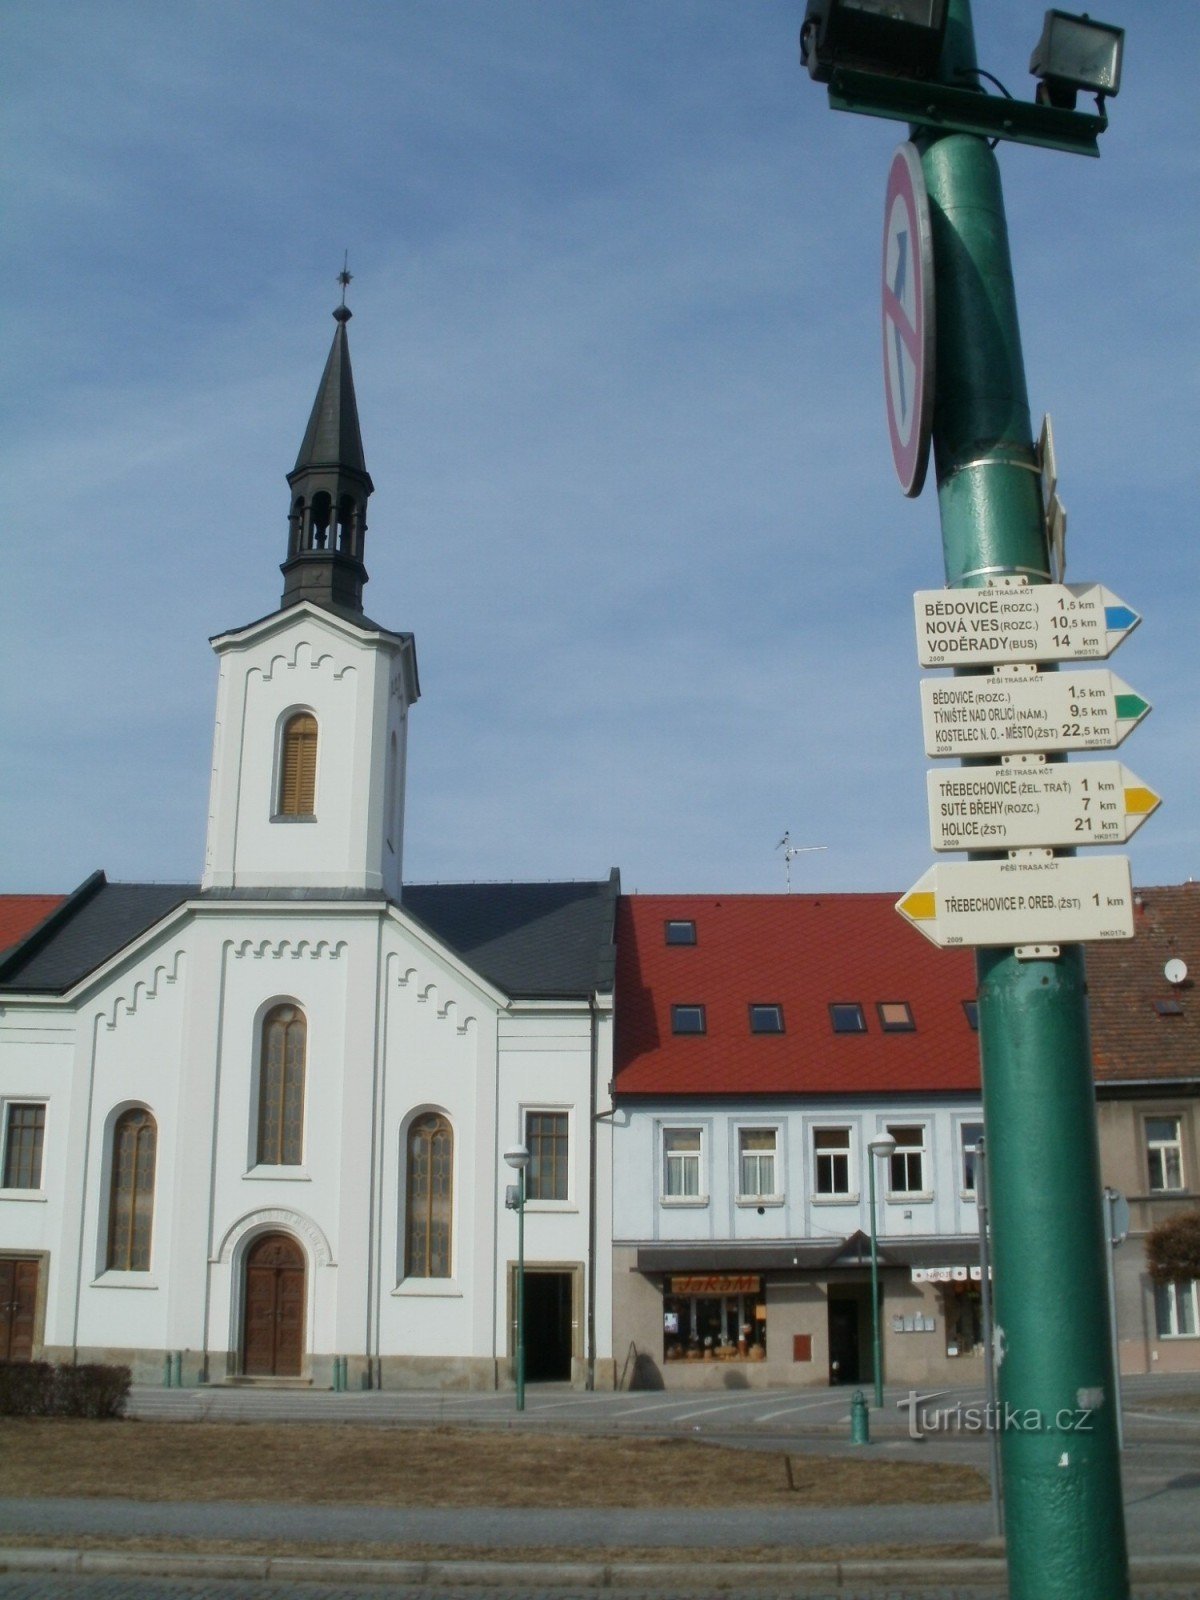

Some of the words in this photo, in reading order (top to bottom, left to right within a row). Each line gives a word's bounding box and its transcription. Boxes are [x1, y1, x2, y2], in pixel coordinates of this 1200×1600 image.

[925, 600, 999, 616] BĚDOVICE
[1000, 603, 1039, 614] (ROZC.)
[1058, 598, 1076, 611] 1,5
[1079, 600, 1094, 609] km
[926, 620, 967, 634] NOVÁ
[970, 619, 999, 631] VES
[1000, 620, 1039, 631] (ROZC.)
[1050, 617, 1078, 629] 10,5
[1081, 619, 1097, 627] km
[928, 637, 1009, 652] VODĚRADY
[1009, 639, 1038, 650] (BUS)
[1052, 635, 1070, 647] 14
[1082, 637, 1099, 646] km
[933, 689, 974, 704] BĚDOVICE
[975, 692, 1011, 703] (ROZC.)
[1069, 686, 1086, 698] 1,5
[1089, 688, 1105, 697] km
[934, 708, 966, 723] TÝNIŠTĚ
[969, 708, 986, 722] NAD
[988, 705, 1015, 720] ORLICÍ
[1016, 709, 1047, 720] (NÁM.)
[1070, 704, 1088, 716] 9,5
[1091, 707, 1107, 716] km
[935, 727, 979, 742] KOSTELEC
[981, 728, 991, 740] N.
[991, 727, 999, 739] O.
[1005, 724, 1034, 739] MĚSTO
[1034, 727, 1058, 739] (ŽST)
[1062, 724, 1090, 736] 22,5
[1093, 726, 1109, 735] km
[939, 781, 1017, 797] TŘEBECHOVICE
[1018, 782, 1041, 795] (ŽEL.
[1043, 782, 1071, 794] TRAŤ)
[1081, 779, 1088, 791] 1
[1098, 781, 1115, 791] km
[941, 800, 967, 816] SUTÉ
[970, 799, 1004, 815] BŘEHY
[1004, 803, 1040, 814] (ROZC.)
[1082, 798, 1090, 810] 7
[1100, 801, 1116, 810] km
[942, 822, 979, 836] HOLICE
[980, 823, 1007, 835] (ŽST)
[1075, 818, 1092, 830] 21
[1101, 820, 1118, 830] km
[945, 896, 1016, 913] TŘEBECHOVICE
[1019, 898, 1027, 910] P.
[1029, 896, 1056, 909] OREB.
[1058, 898, 1081, 910] (ŽST)
[1093, 893, 1100, 906] 1
[1107, 897, 1124, 906] km
